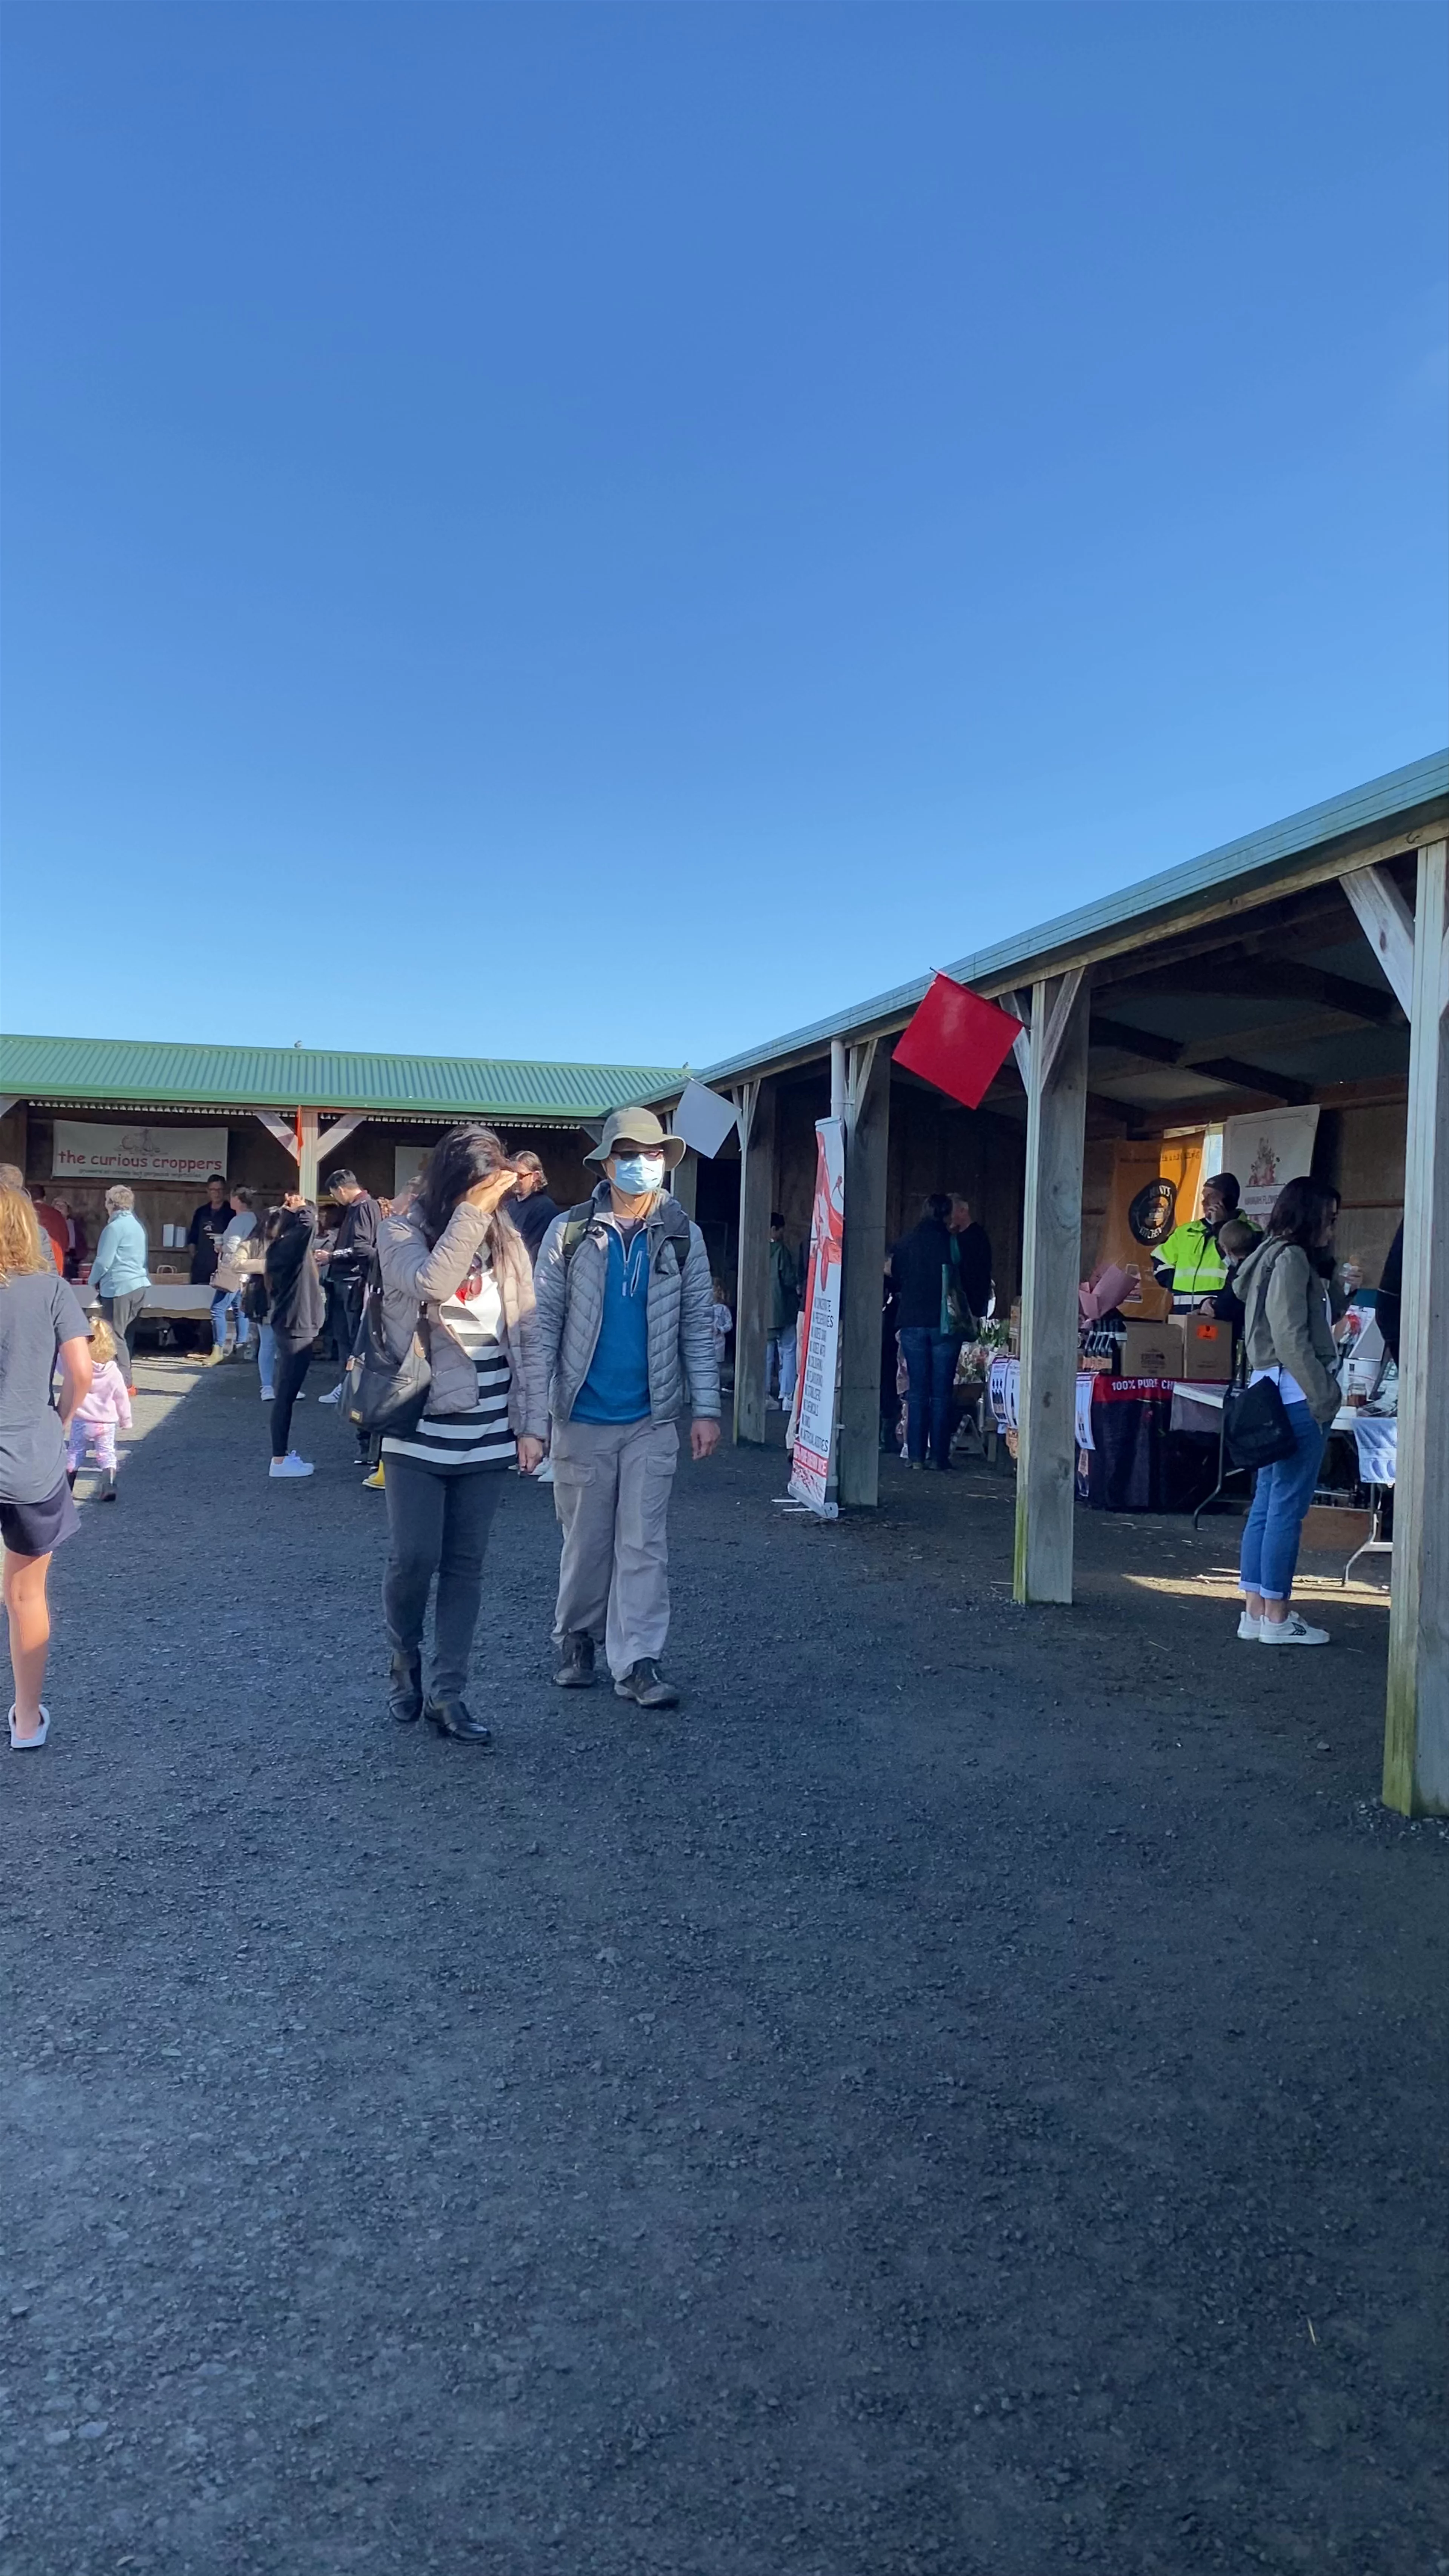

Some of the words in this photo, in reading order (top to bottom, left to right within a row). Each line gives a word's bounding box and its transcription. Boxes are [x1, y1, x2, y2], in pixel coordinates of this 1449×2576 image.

[58, 1150, 86, 1164] the
[91, 1154, 148, 1167] curious
[152, 1158, 222, 1173] croppers
[1139, 1226, 1162, 1239] KITCHEN
[1112, 1380, 1136, 1390] 100%
[1138, 1379, 1158, 1389] PURE
